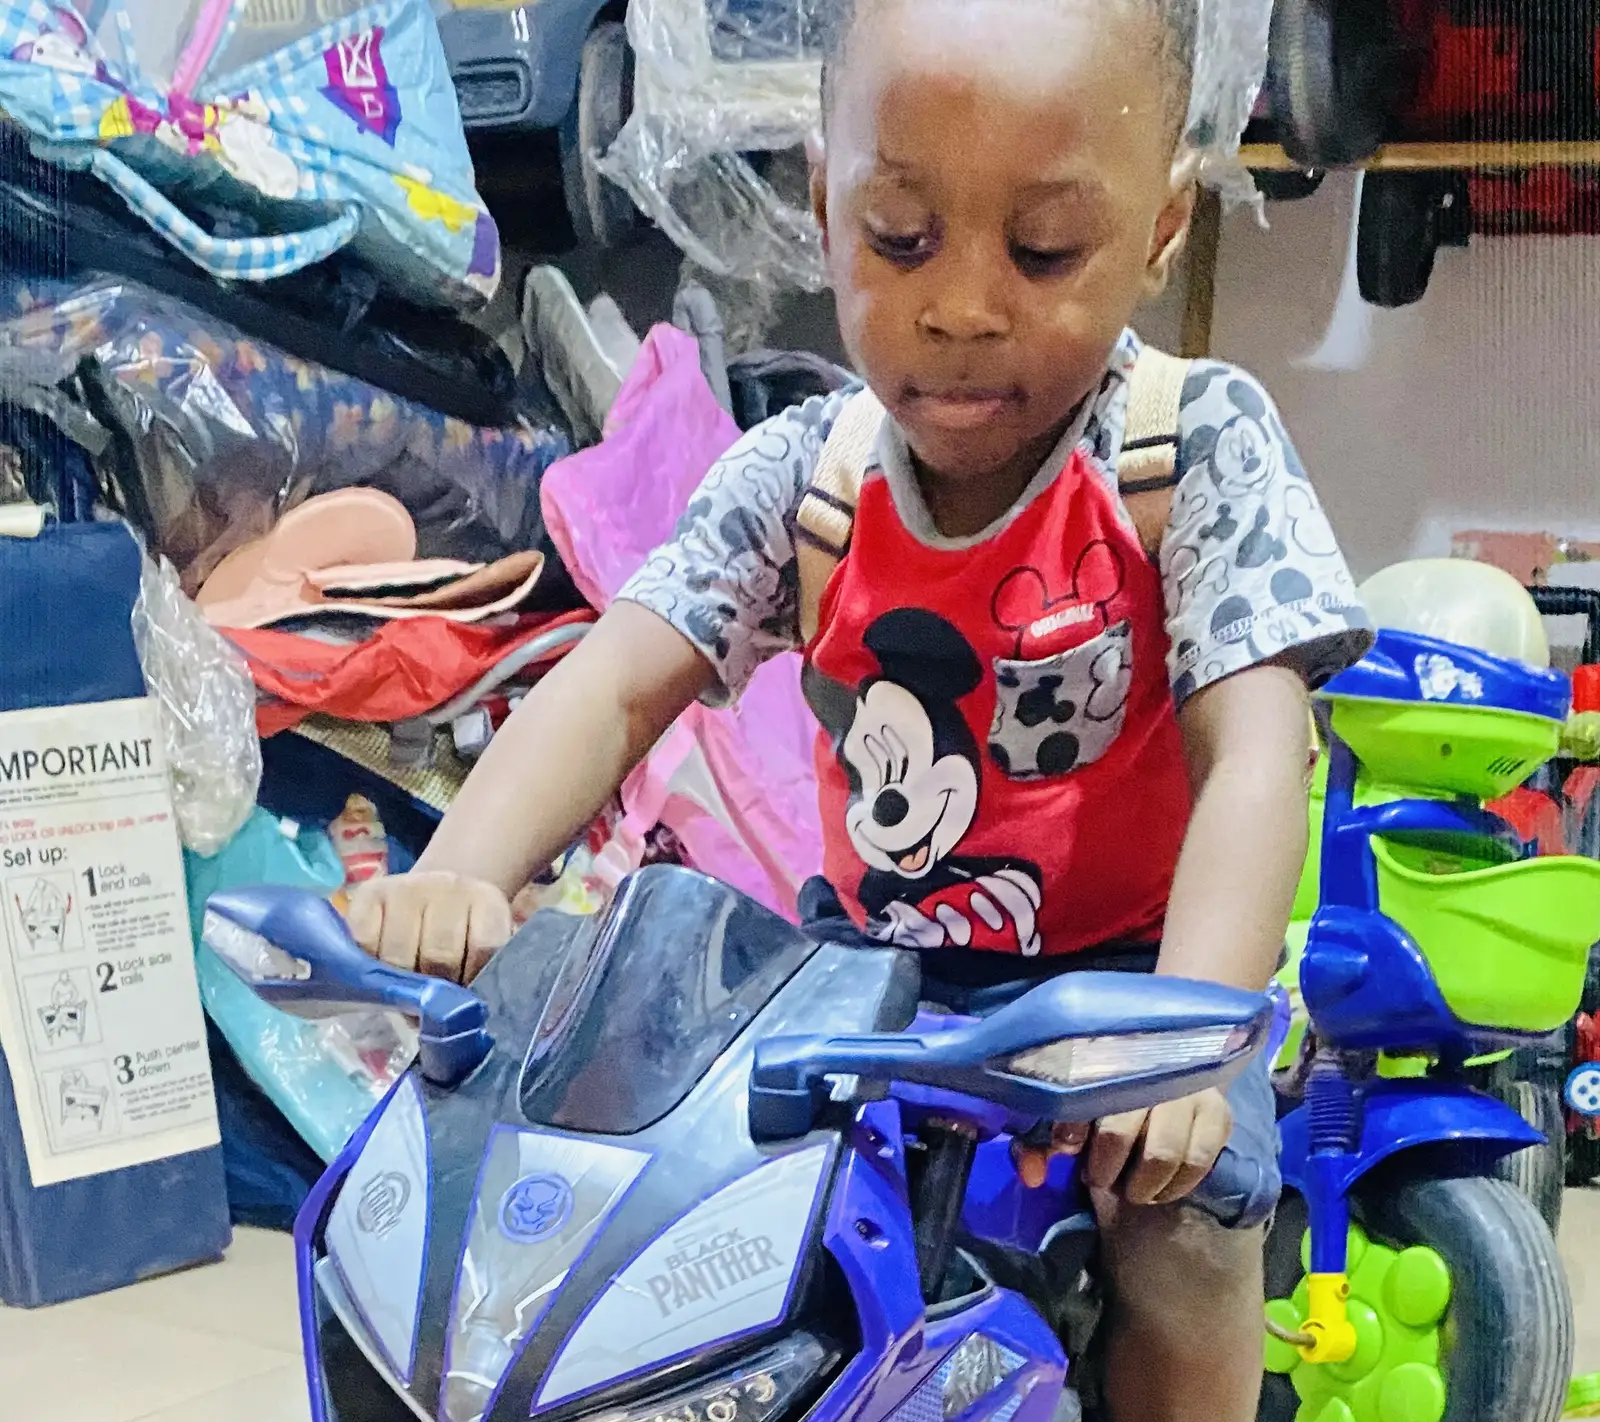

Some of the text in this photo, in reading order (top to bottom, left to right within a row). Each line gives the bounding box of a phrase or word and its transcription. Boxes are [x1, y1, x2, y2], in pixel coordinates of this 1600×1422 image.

[0, 738, 152, 782] MPORTANT
[3, 846, 68, 868] Set up:
[82, 866, 97, 897] 1
[96, 961, 118, 993] 2
[113, 1054, 135, 1085] 3
[665, 1226, 746, 1271] BLACK
[645, 1234, 786, 1319] PANTHER
